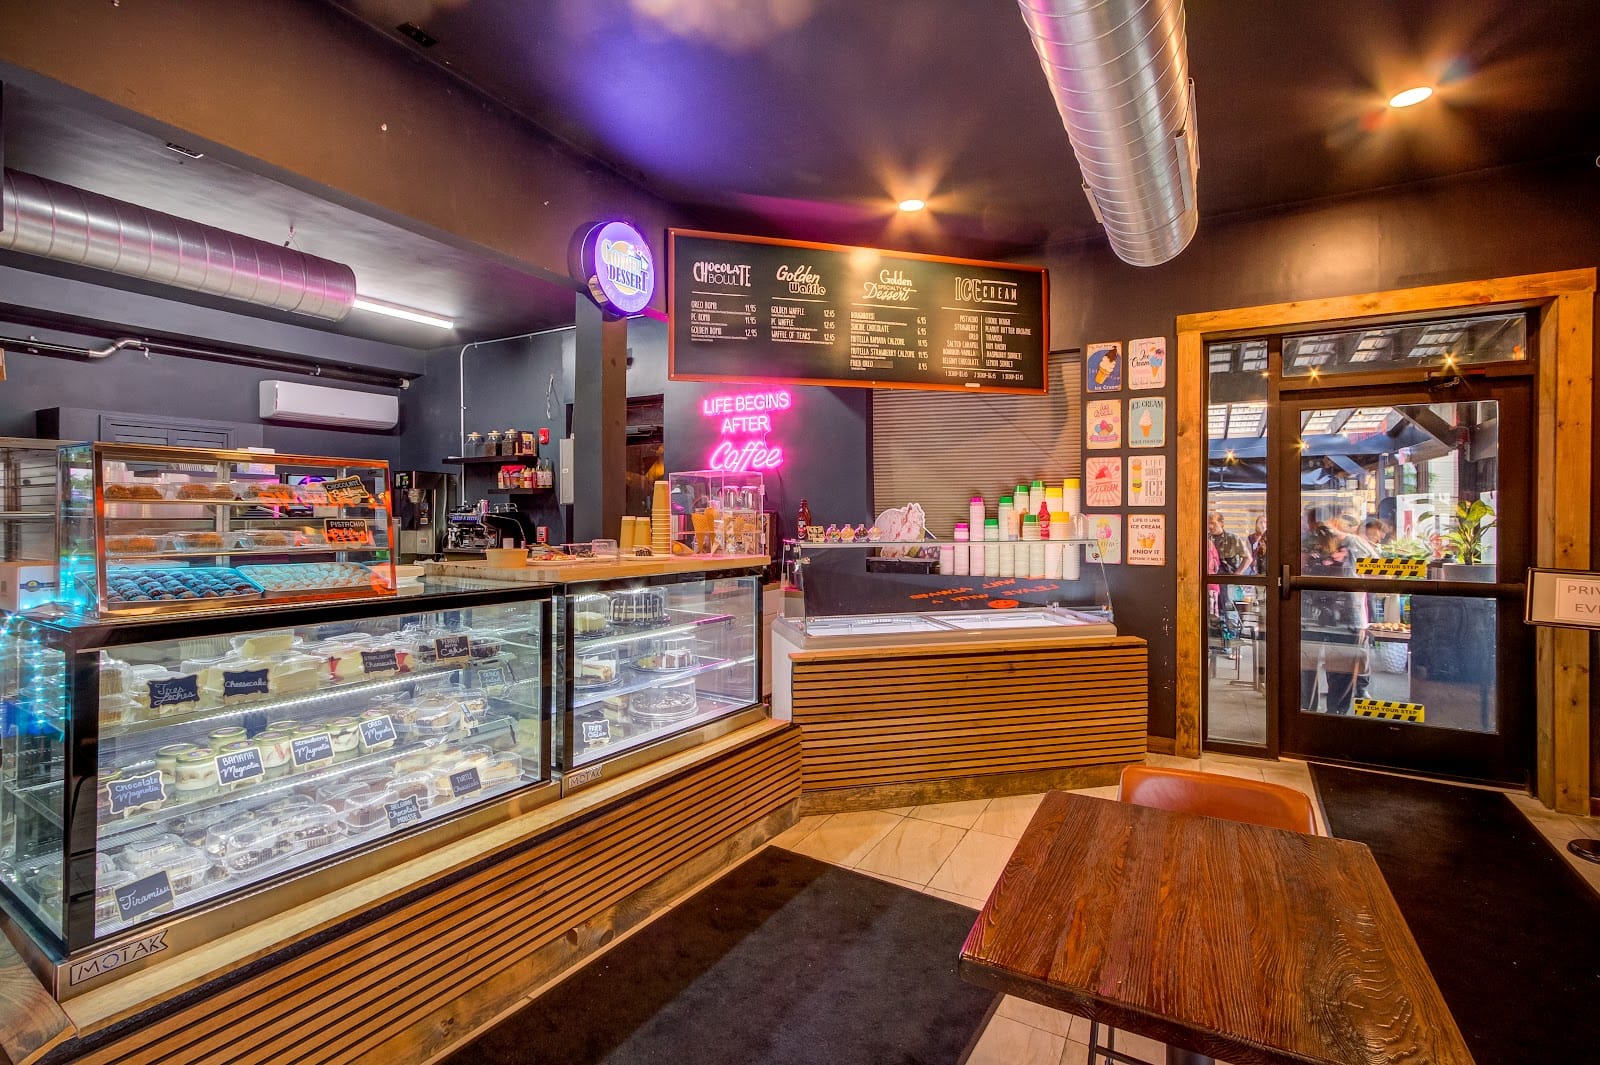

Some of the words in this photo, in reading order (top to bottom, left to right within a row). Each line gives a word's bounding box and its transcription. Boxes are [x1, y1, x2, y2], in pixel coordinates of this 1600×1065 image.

[606, 263, 648, 293] DESSERT
[693, 261, 751, 287] CHOCOLATE
[776, 265, 821, 283] Golden
[880, 270, 912, 286] Golden
[862, 282, 917, 302] Dessert
[955, 277, 982, 303] ICE
[983, 286, 1018, 300] CREAM
[703, 397, 733, 414] LIFE
[736, 392, 791, 412] BEGINS
[721, 415, 770, 434] AFTER
[709, 440, 783, 472] Coffee
[1576, 604, 1600, 614] EV
[154, 684, 184, 695] Tres
[224, 678, 267, 688] Cheesecake
[154, 691, 196, 705] Leches
[368, 720, 382, 728] OREO
[222, 752, 255, 766] BANANA
[120, 885, 170, 910] Tiramisu
[78, 936, 159, 980] MOTAK
